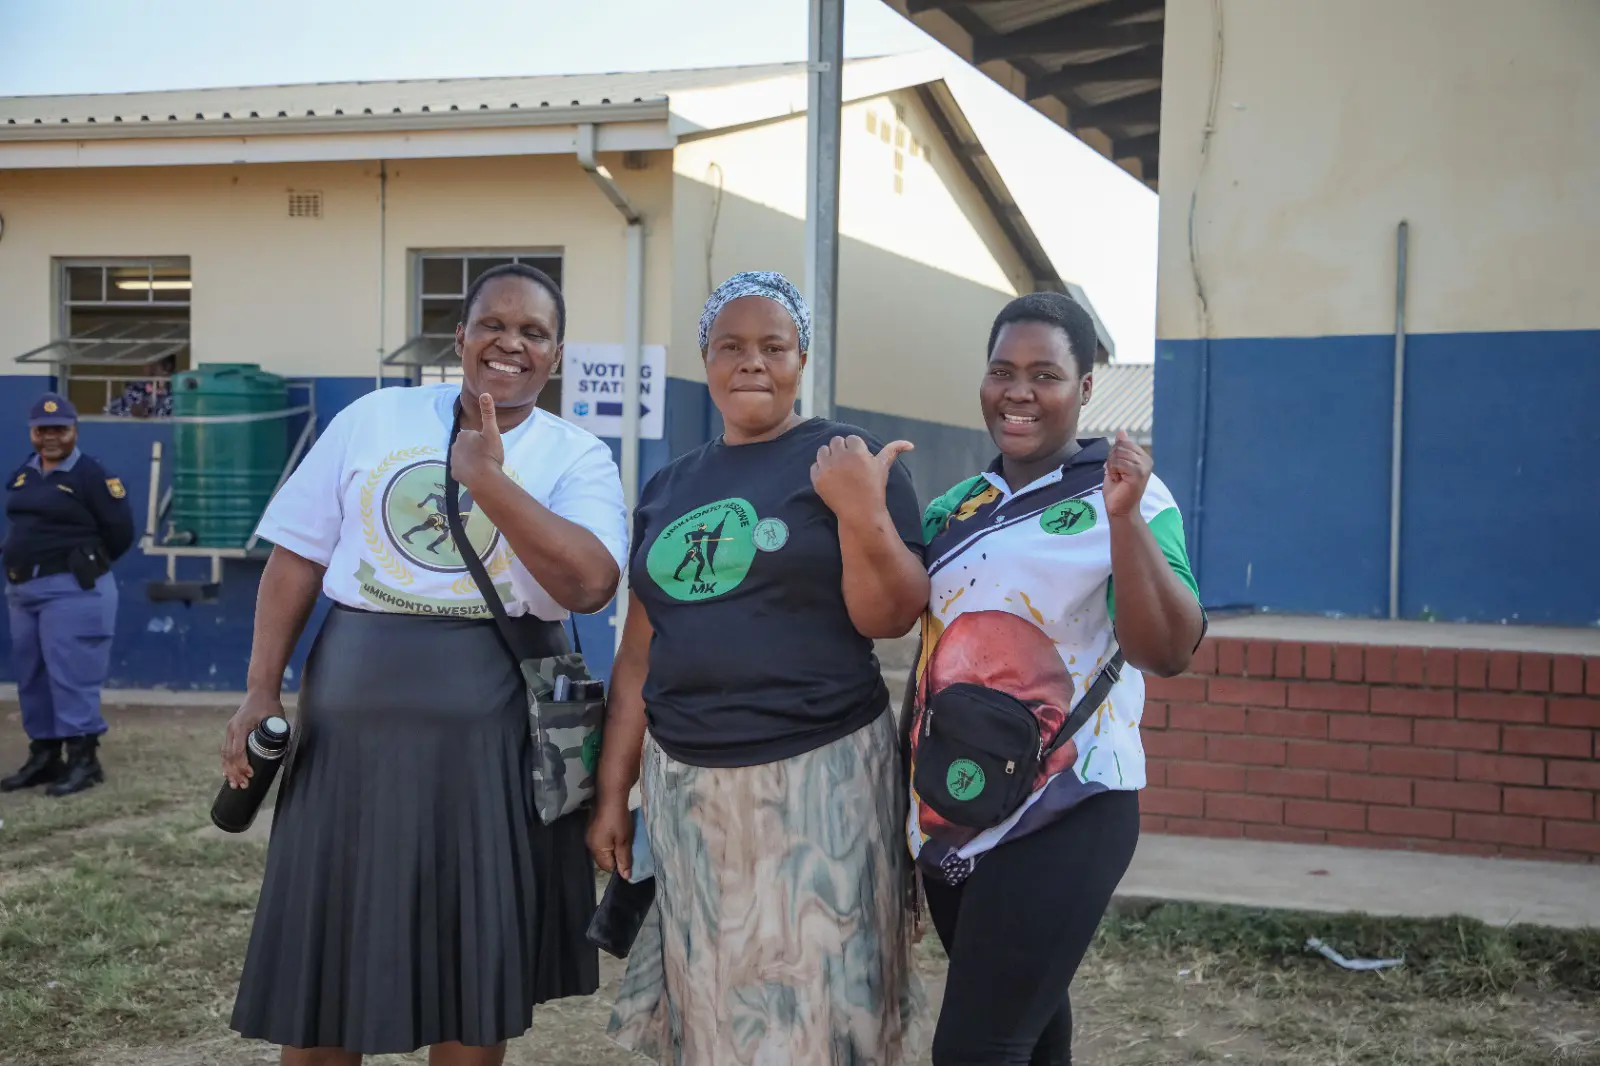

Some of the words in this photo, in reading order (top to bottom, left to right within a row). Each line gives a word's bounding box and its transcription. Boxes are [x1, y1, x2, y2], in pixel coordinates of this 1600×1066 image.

[582, 363, 652, 379] VOTIG
[578, 381, 651, 395] STATN
[689, 582, 717, 595] MK
[363, 583, 433, 613] uMKHONTO
